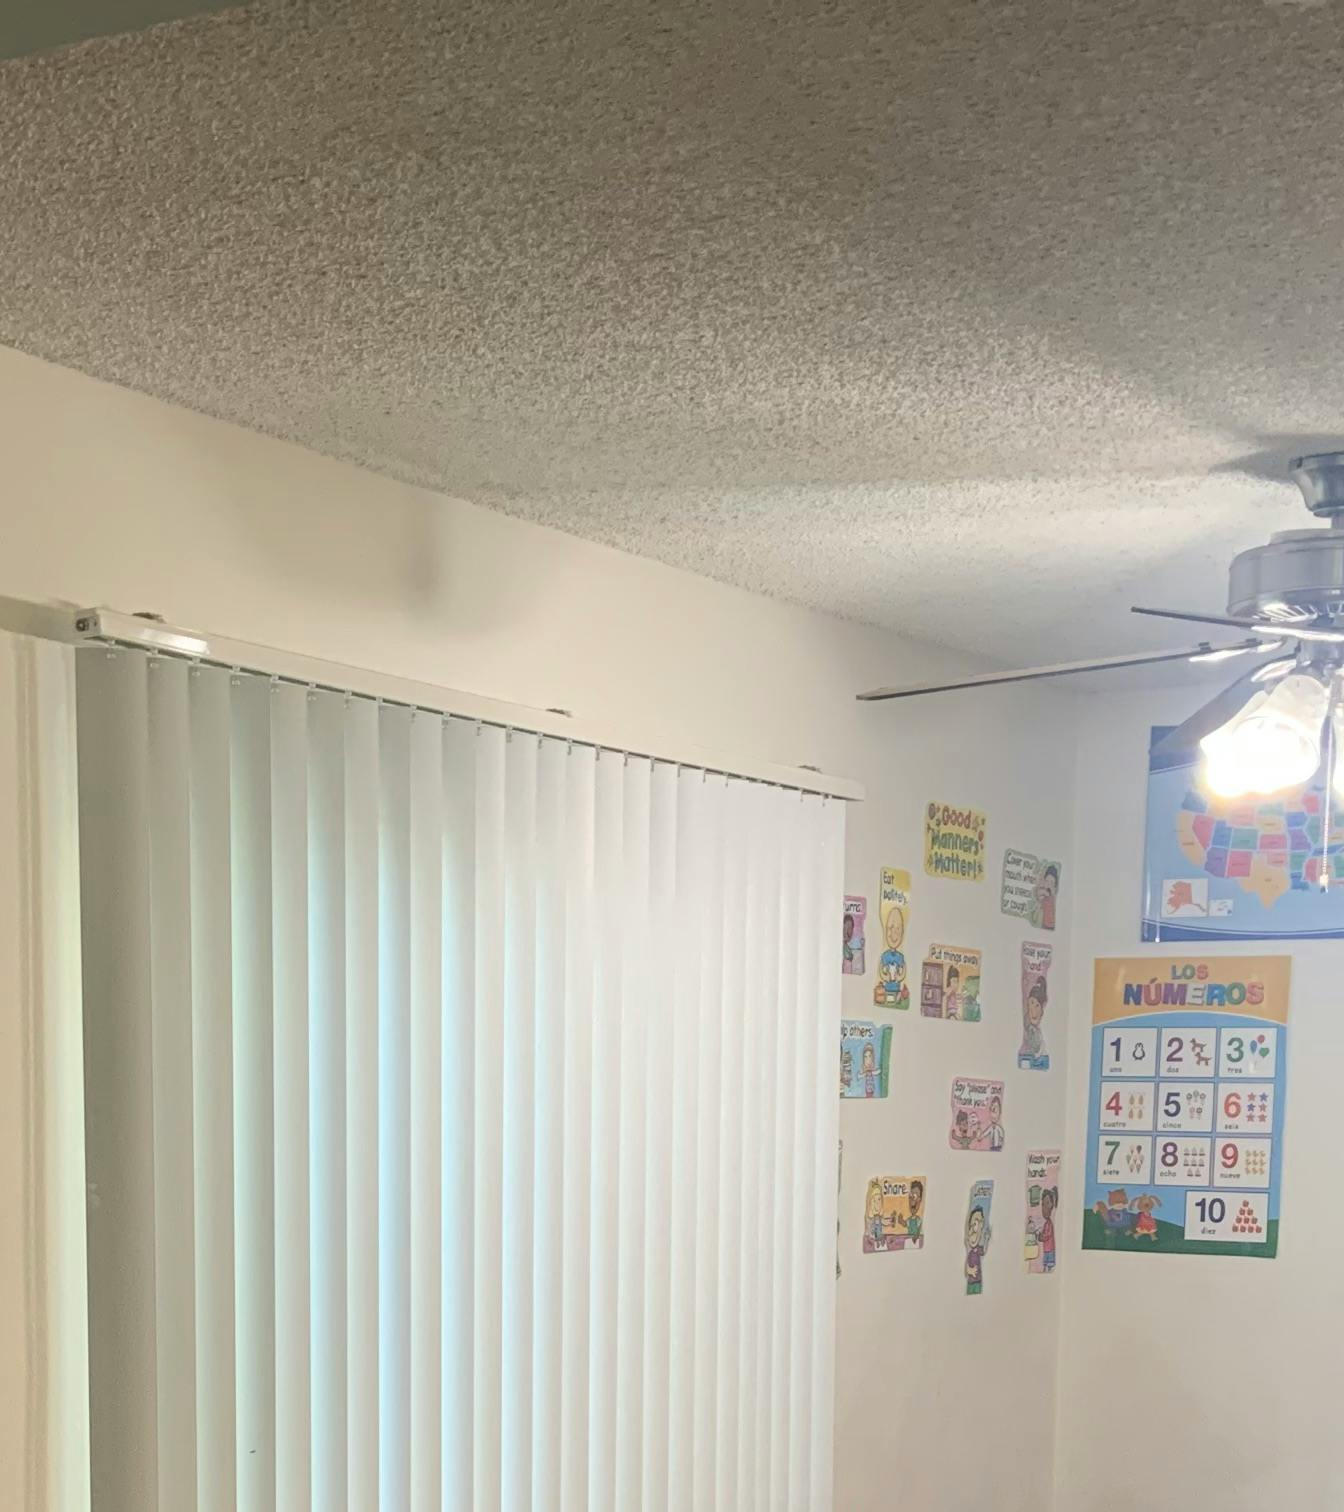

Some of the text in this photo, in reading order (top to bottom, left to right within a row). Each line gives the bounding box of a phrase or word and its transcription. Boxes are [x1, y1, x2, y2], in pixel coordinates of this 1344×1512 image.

[942, 805, 972, 829] Good
[931, 829, 979, 856] Manners
[883, 871, 895, 885] Eat
[1171, 963, 1209, 981] LOS
[1123, 977, 1265, 1007] NÚMEROS
[1109, 1037, 1122, 1062] 1
[1166, 1037, 1184, 1062] 2
[1226, 1037, 1244, 1063] 3
[1105, 1091, 1123, 1117] 4
[1163, 1091, 1181, 1117] 5
[1223, 1092, 1242, 1118] 6
[1104, 1140, 1121, 1165] 7
[1160, 1141, 1179, 1167] 8
[1221, 1142, 1239, 1169] 9
[1194, 1197, 1226, 1224] 10
